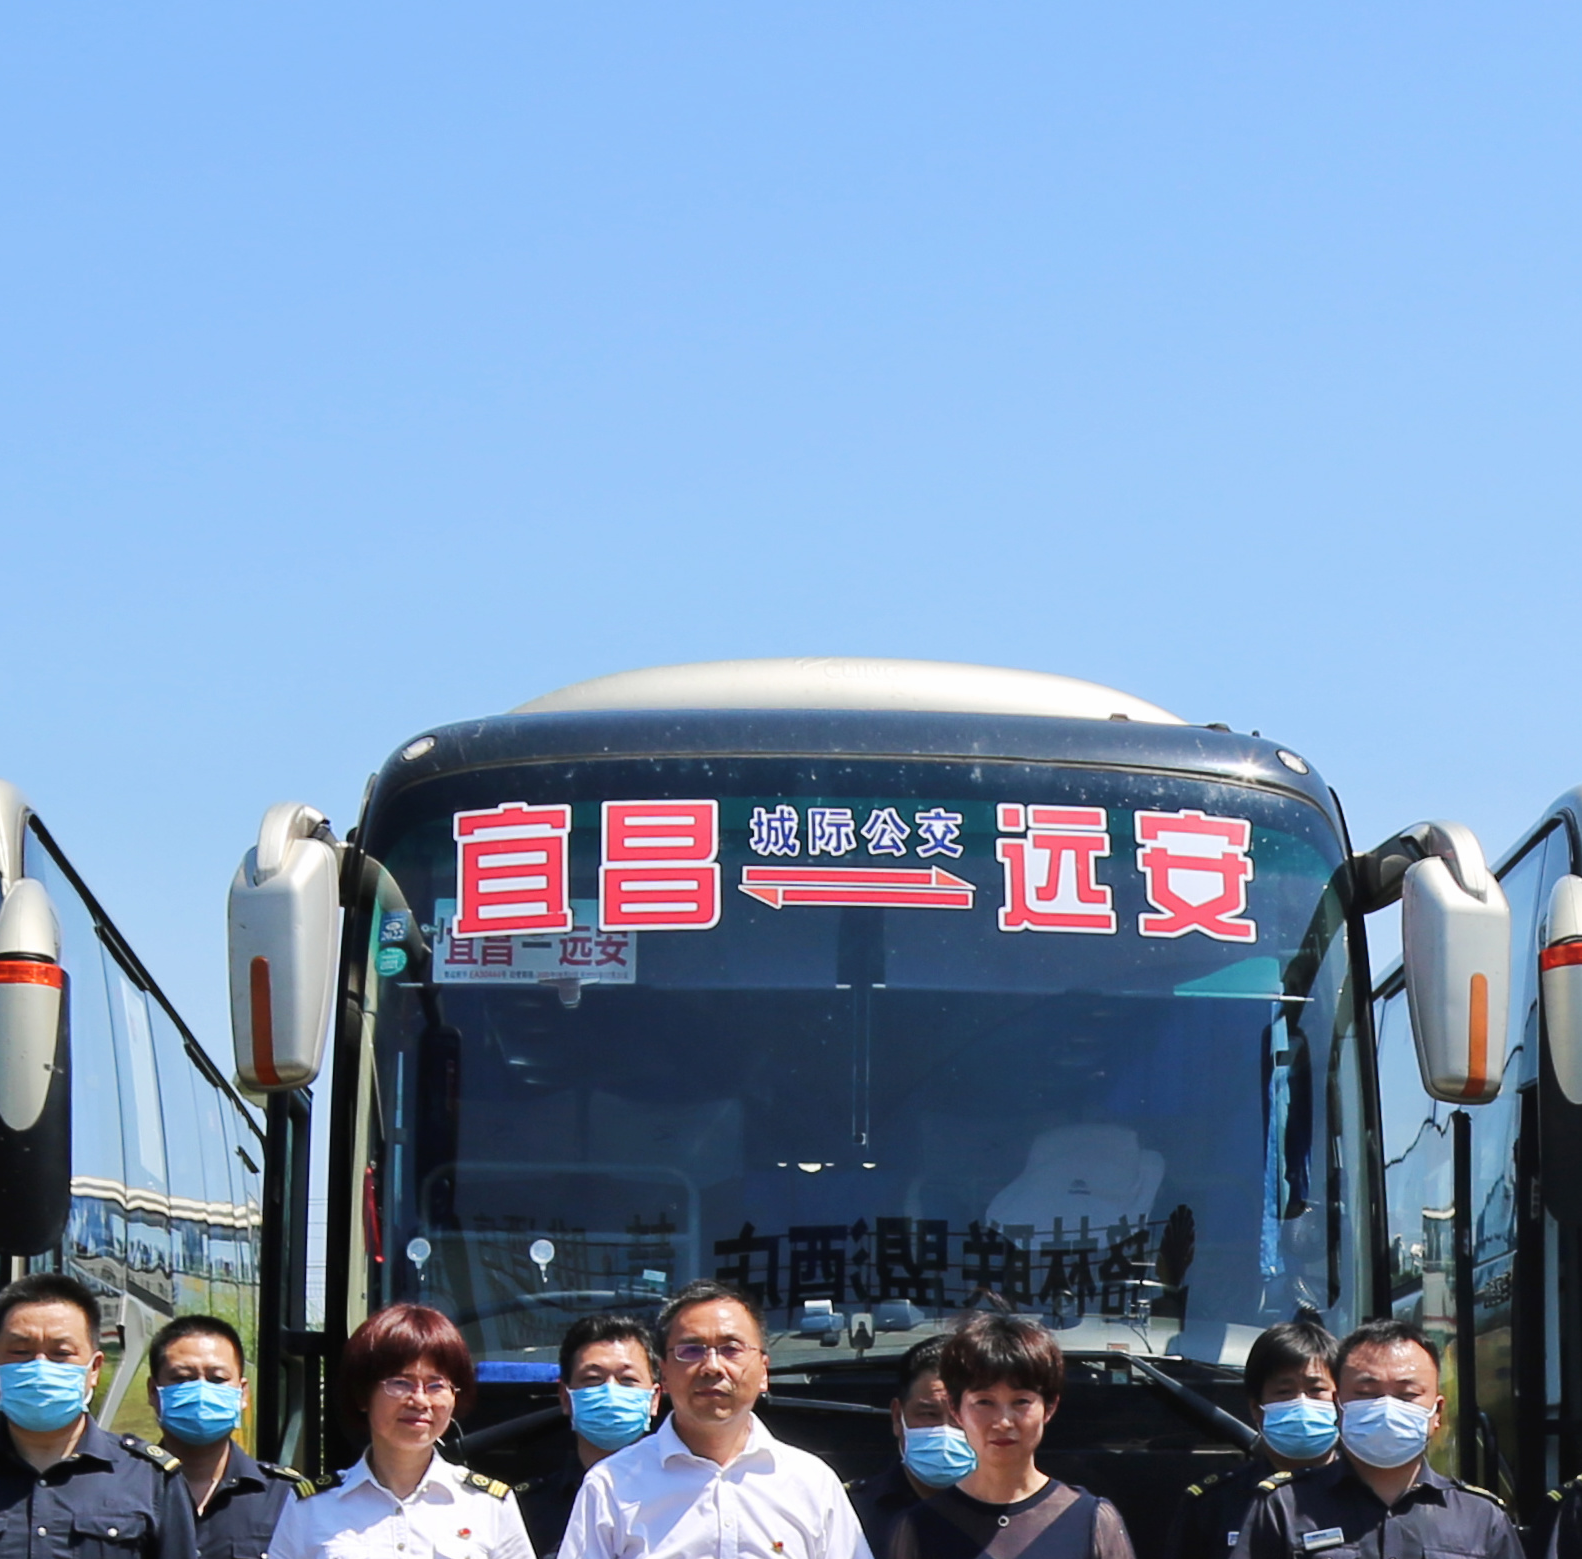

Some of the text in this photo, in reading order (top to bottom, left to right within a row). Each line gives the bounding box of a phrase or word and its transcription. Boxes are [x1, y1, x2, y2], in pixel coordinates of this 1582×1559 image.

[452, 799, 1257, 943] 宜昌 城际公交 远安
